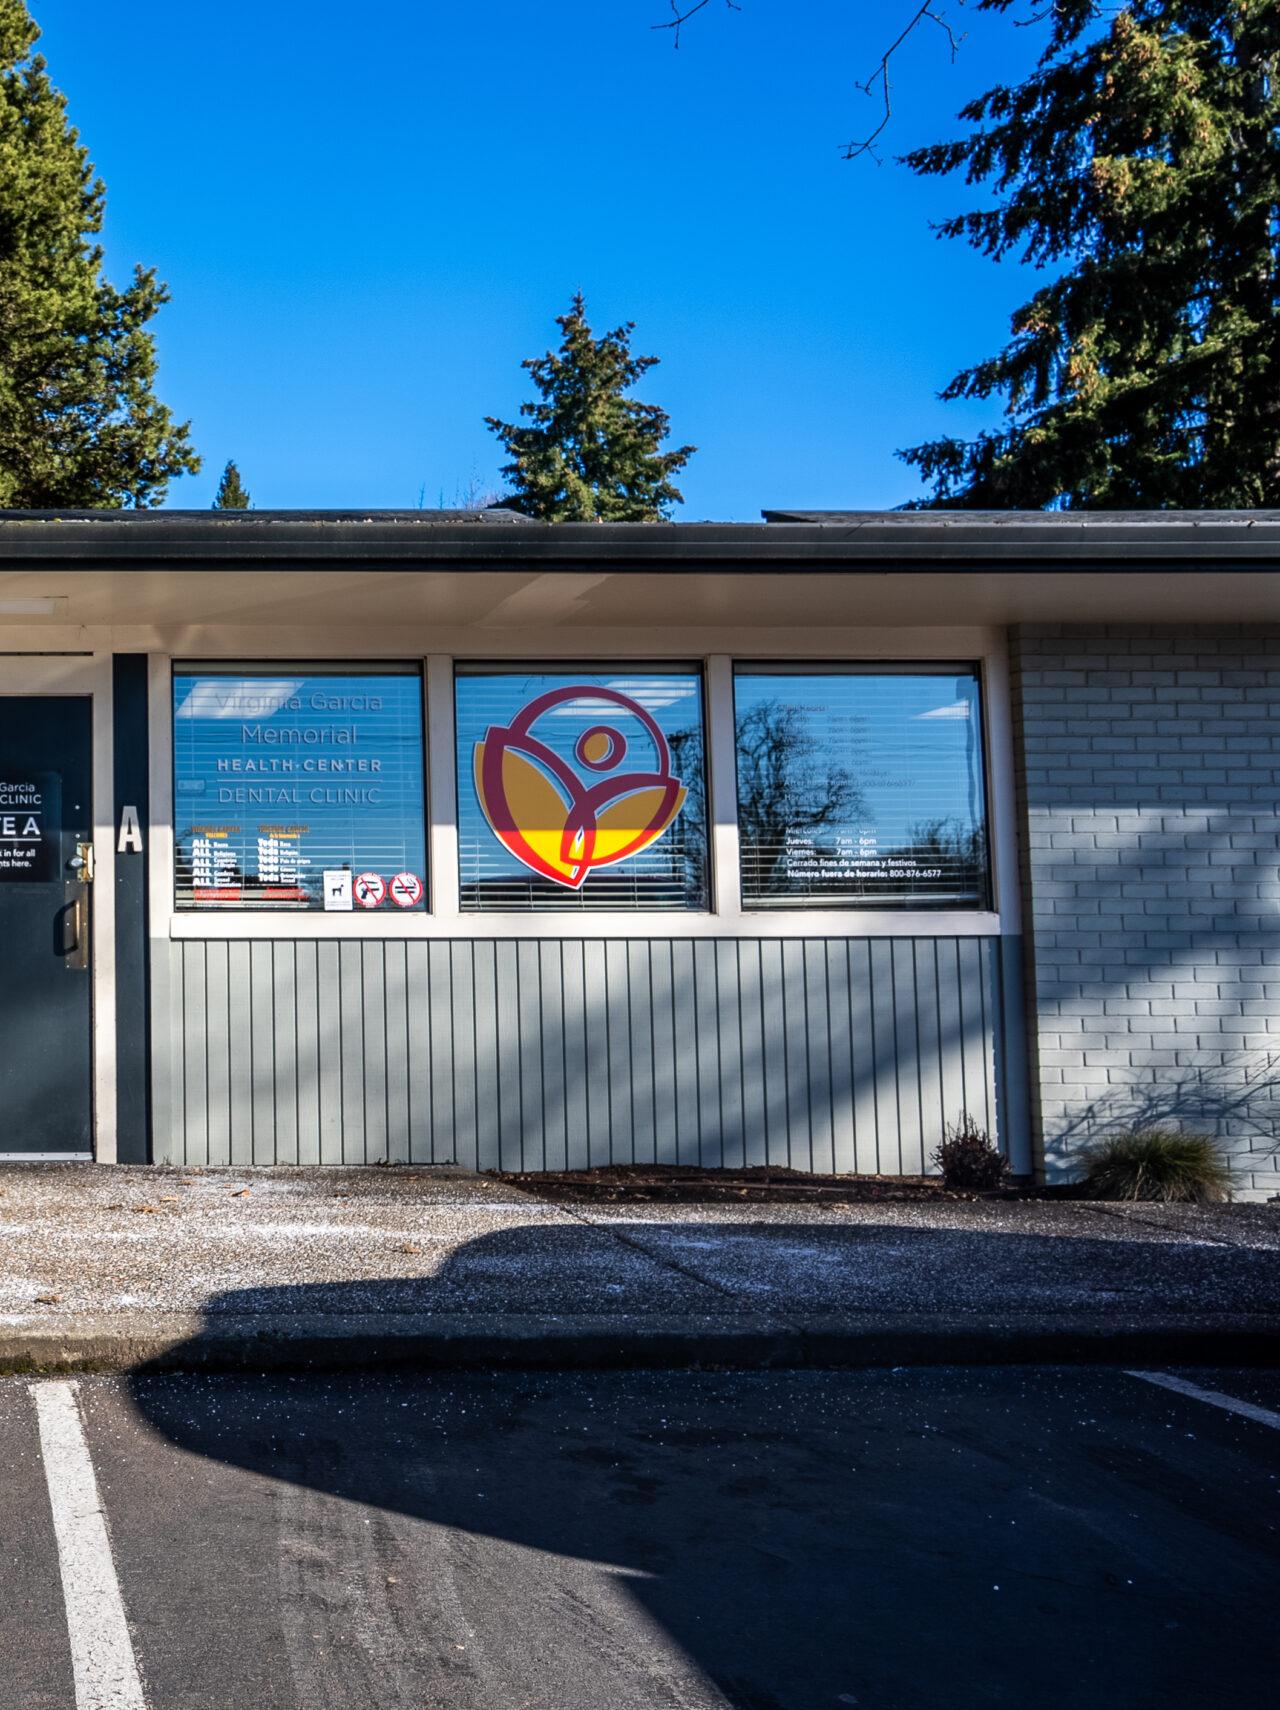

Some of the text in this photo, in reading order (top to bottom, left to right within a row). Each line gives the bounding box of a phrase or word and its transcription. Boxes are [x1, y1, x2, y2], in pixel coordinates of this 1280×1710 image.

[310, 691, 383, 711] Garcia
[241, 724, 357, 745] Memorial
[217, 759, 382, 772] HEALTH CENTER
[0, 794, 42, 805] CLINIC
[219, 788, 381, 804] DENTAL CLINIC
[22, 816, 41, 836] A
[118, 806, 143, 852] A
[192, 839, 211, 847] ALL
[258, 838, 278, 847] Toda
[786, 837, 813, 845] Jueves:
[836, 837, 852, 845] 7am
[859, 837, 877, 847] 6pm
[4, 849, 11, 857] in
[13, 849, 25, 857] for
[26, 849, 36, 857] all
[192, 848, 211, 857] ALL
[258, 847, 278, 856] Toda
[786, 848, 816, 856] Viernes:
[836, 848, 853, 856] 7am
[859, 848, 877, 857] 6pm
[11, 859, 31, 867] here.
[192, 858, 211, 867] ALL
[786, 859, 818, 867] Cerrado
[881, 860, 887, 868] y
[192, 868, 211, 876] ALL
[787, 869, 942, 878] Número fuera de horario: 800-876-6577
[192, 877, 211, 886] ALL
[258, 873, 278, 882] Toda
